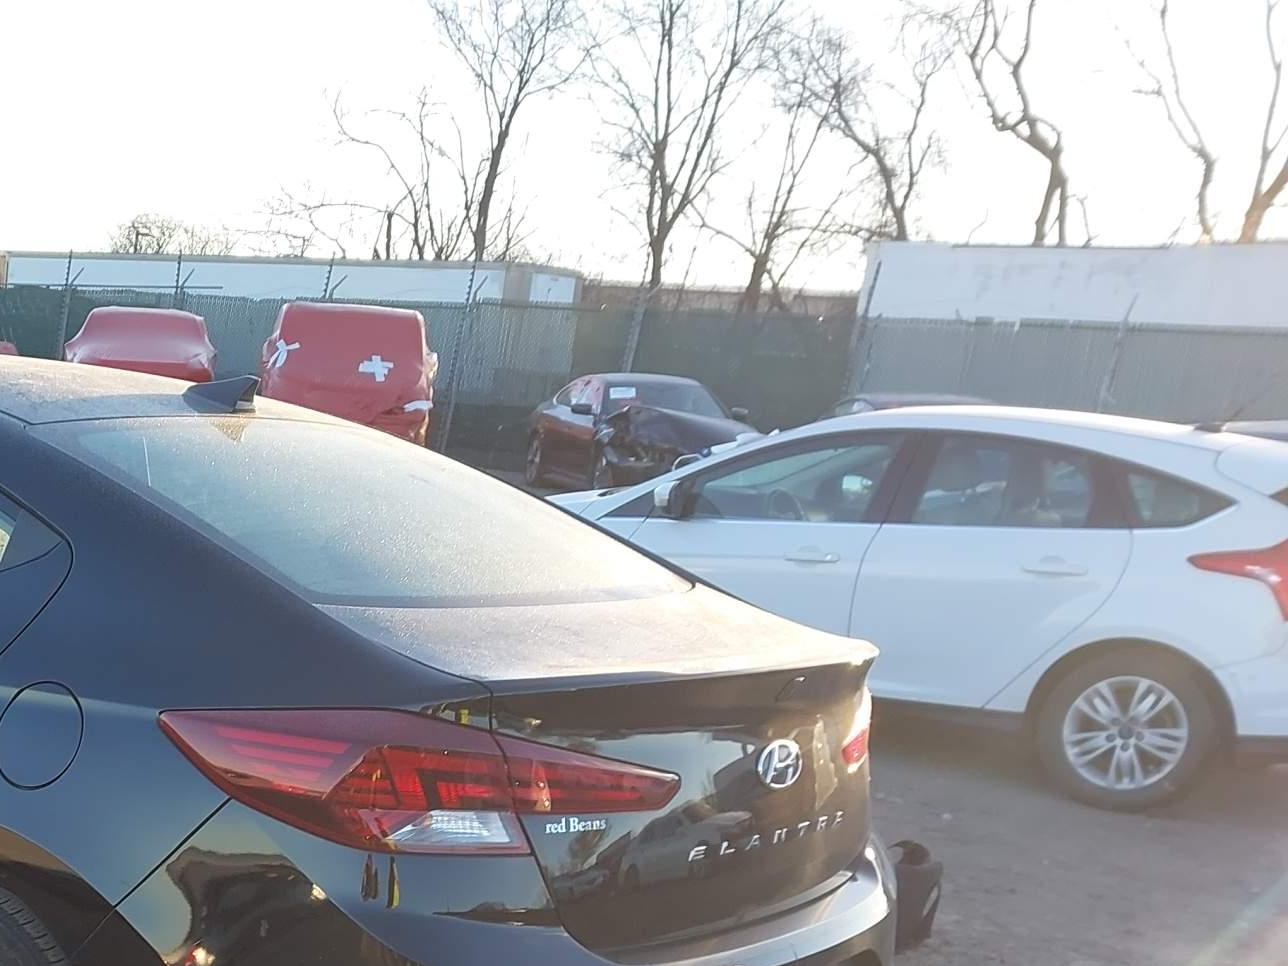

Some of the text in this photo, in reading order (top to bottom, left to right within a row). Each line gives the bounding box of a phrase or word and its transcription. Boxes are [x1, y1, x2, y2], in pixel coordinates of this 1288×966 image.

[545, 816, 607, 834] red Beans
[688, 810, 844, 862] ELANTRA
